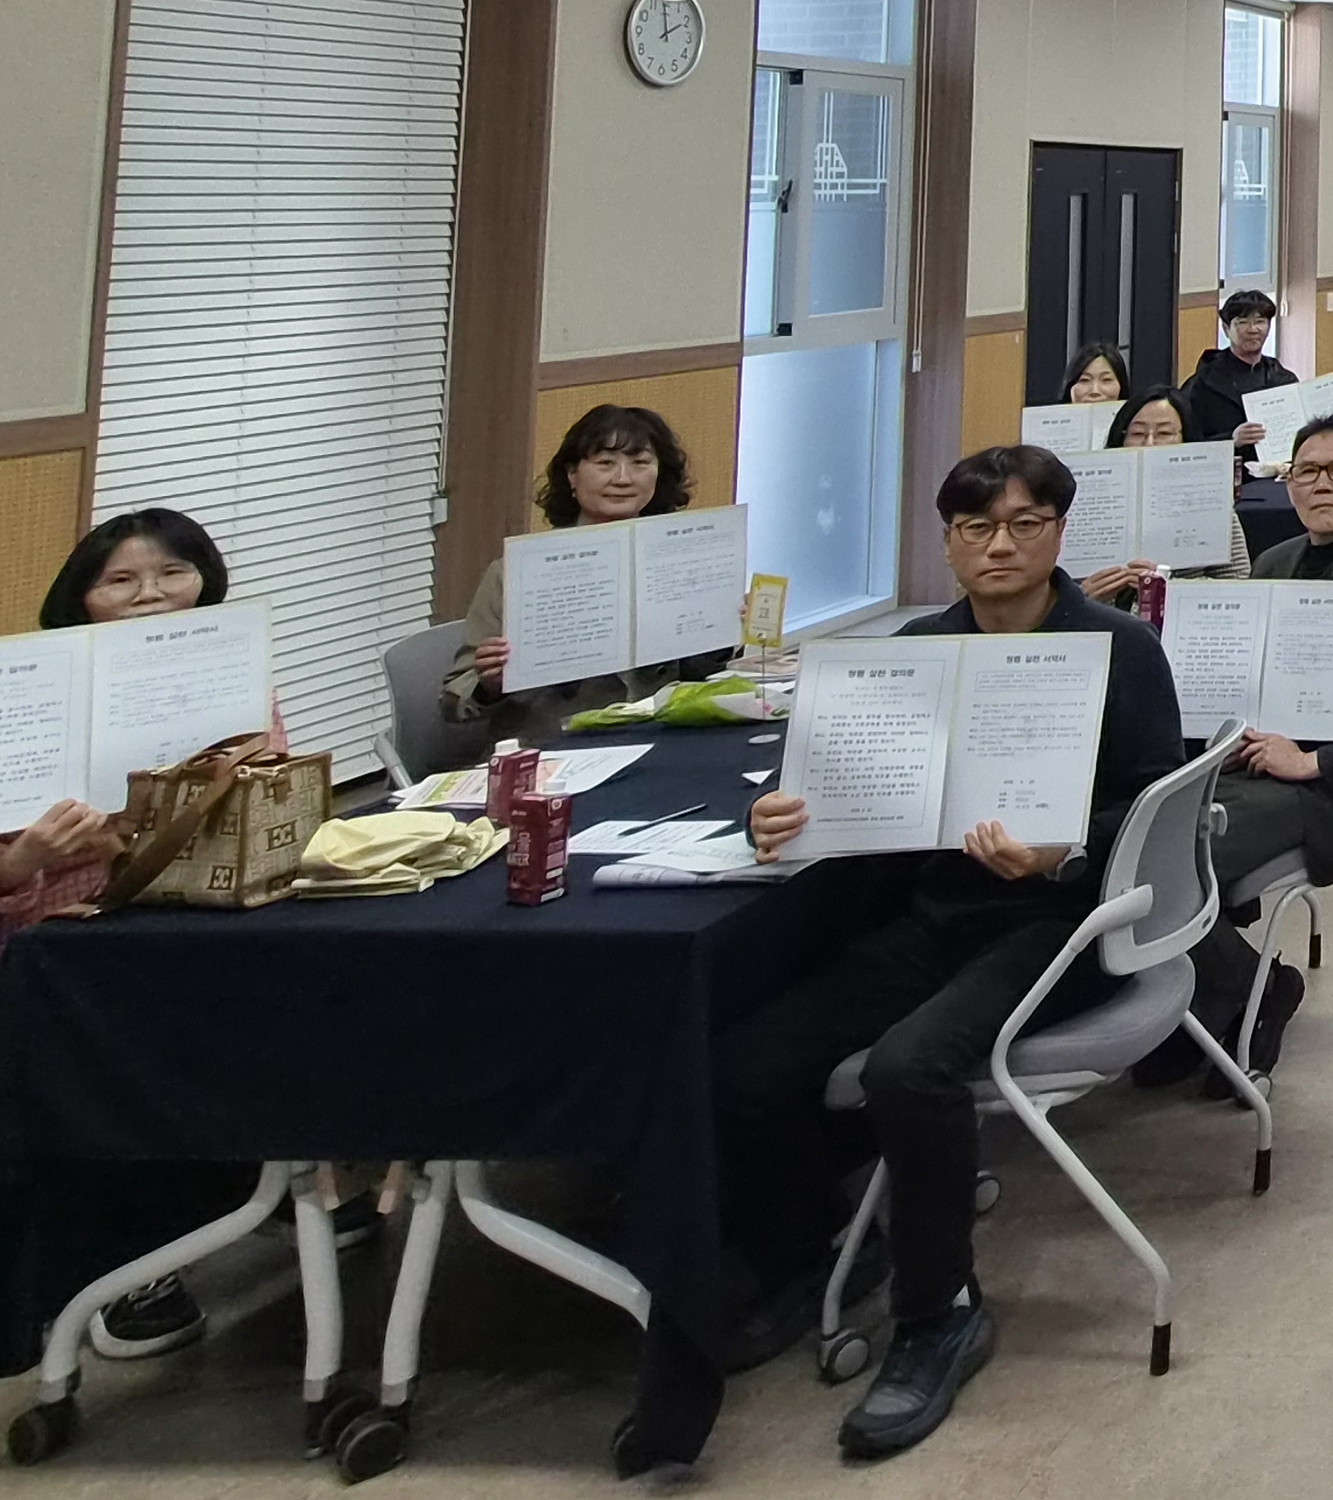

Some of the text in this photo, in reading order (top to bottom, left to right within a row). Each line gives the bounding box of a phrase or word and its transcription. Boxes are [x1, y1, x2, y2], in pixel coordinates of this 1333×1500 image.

[683, 15, 690, 28] 2
[635, 25, 643, 37] 9
[686, 32, 692, 44] 3
[637, 43, 645, 55] 8
[680, 47, 688, 60] 4
[647, 56, 655, 69] 7
[658, 62, 665, 76] 6
[671, 59, 678, 72] 5
